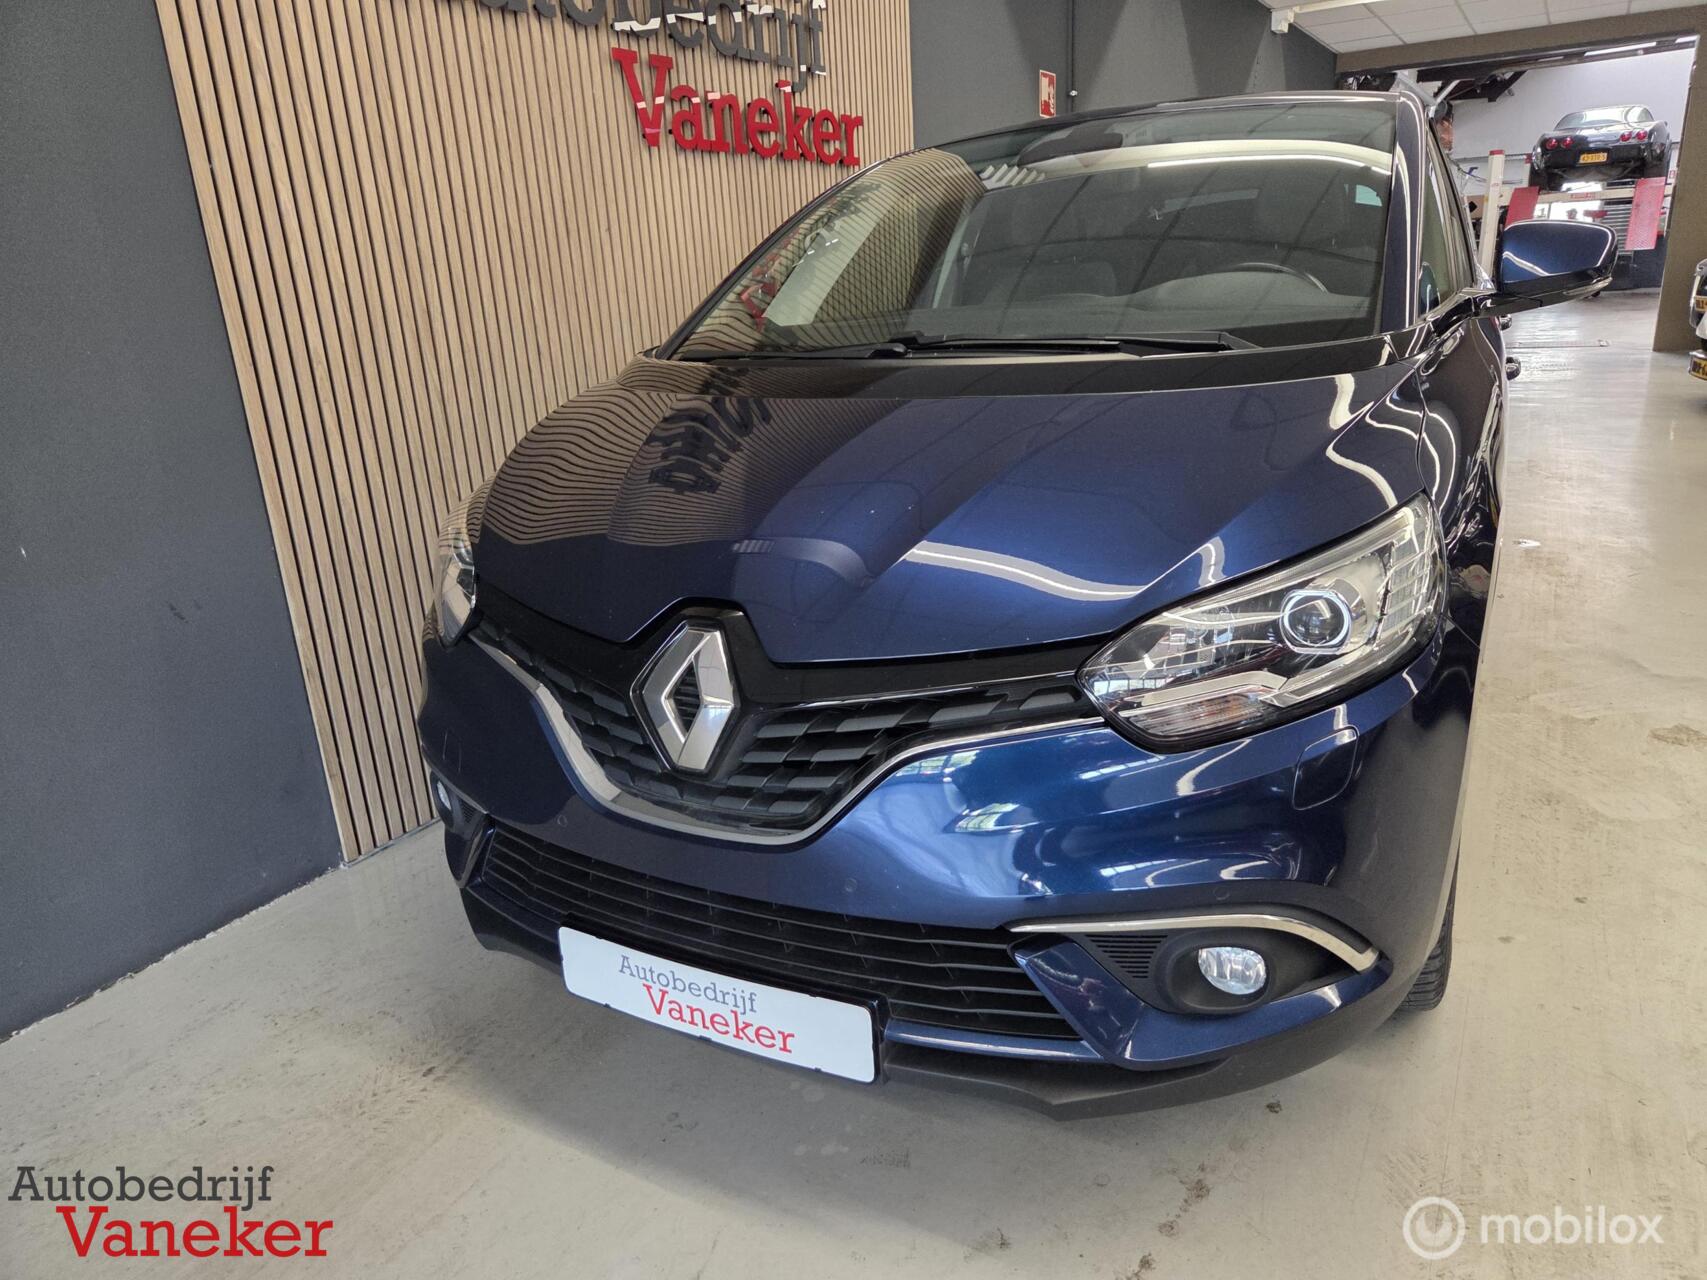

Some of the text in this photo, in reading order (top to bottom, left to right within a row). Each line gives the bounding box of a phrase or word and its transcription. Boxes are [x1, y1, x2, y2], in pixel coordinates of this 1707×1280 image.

[611, 47, 864, 167] Vaneker
[618, 954, 758, 1016] Autobedrijf
[643, 983, 795, 1054] Vaneker
